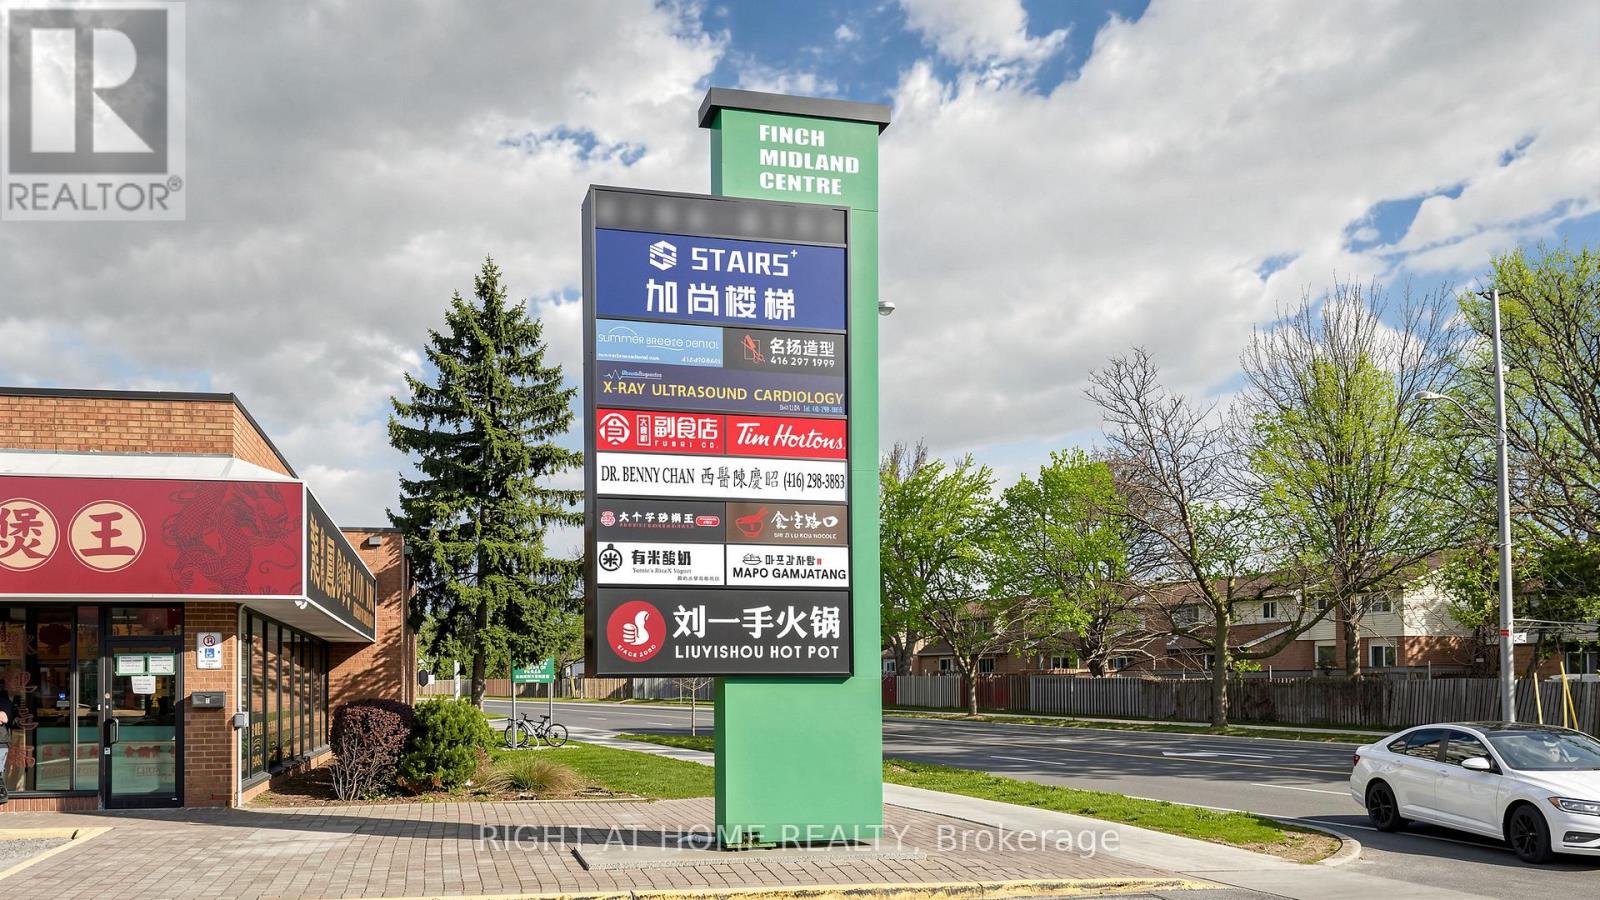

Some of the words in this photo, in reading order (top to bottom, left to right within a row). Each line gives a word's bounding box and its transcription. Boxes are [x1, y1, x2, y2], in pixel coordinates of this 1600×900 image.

[760, 124, 824, 147] FINCH
[760, 149, 859, 174] MIDLAND
[760, 172, 842, 195] CENTRE
[646, 278, 796, 320] 加尚楼梯
[770, 337, 835, 357] 名扬造型
[770, 356, 788, 365] 416
[791, 357, 808, 366] 297
[813, 358, 835, 367] 1999
[603, 381, 645, 394] X-RAY
[652, 384, 747, 400] ULTRASOUND
[754, 389, 844, 404] CARDIOLOGY
[654, 416, 718, 439] 副食店
[736, 422, 770, 445] Tim
[773, 424, 843, 450] Hortons
[601, 465, 620, 481] DR.
[622, 466, 660, 483] BENNY
[662, 467, 695, 484] CHAN
[783, 471, 804, 492] (416)
[807, 473, 845, 489] 298-3883
[632, 550, 691, 565] 有米酸奶
[733, 567, 769, 578] MAPO
[772, 568, 846, 580] GAMJATANG
[672, 604, 840, 639] 刘一手火锅
[675, 645, 764, 659] LIUYISHOU
[770, 645, 802, 659] HOT
[808, 645, 839, 659] POT
